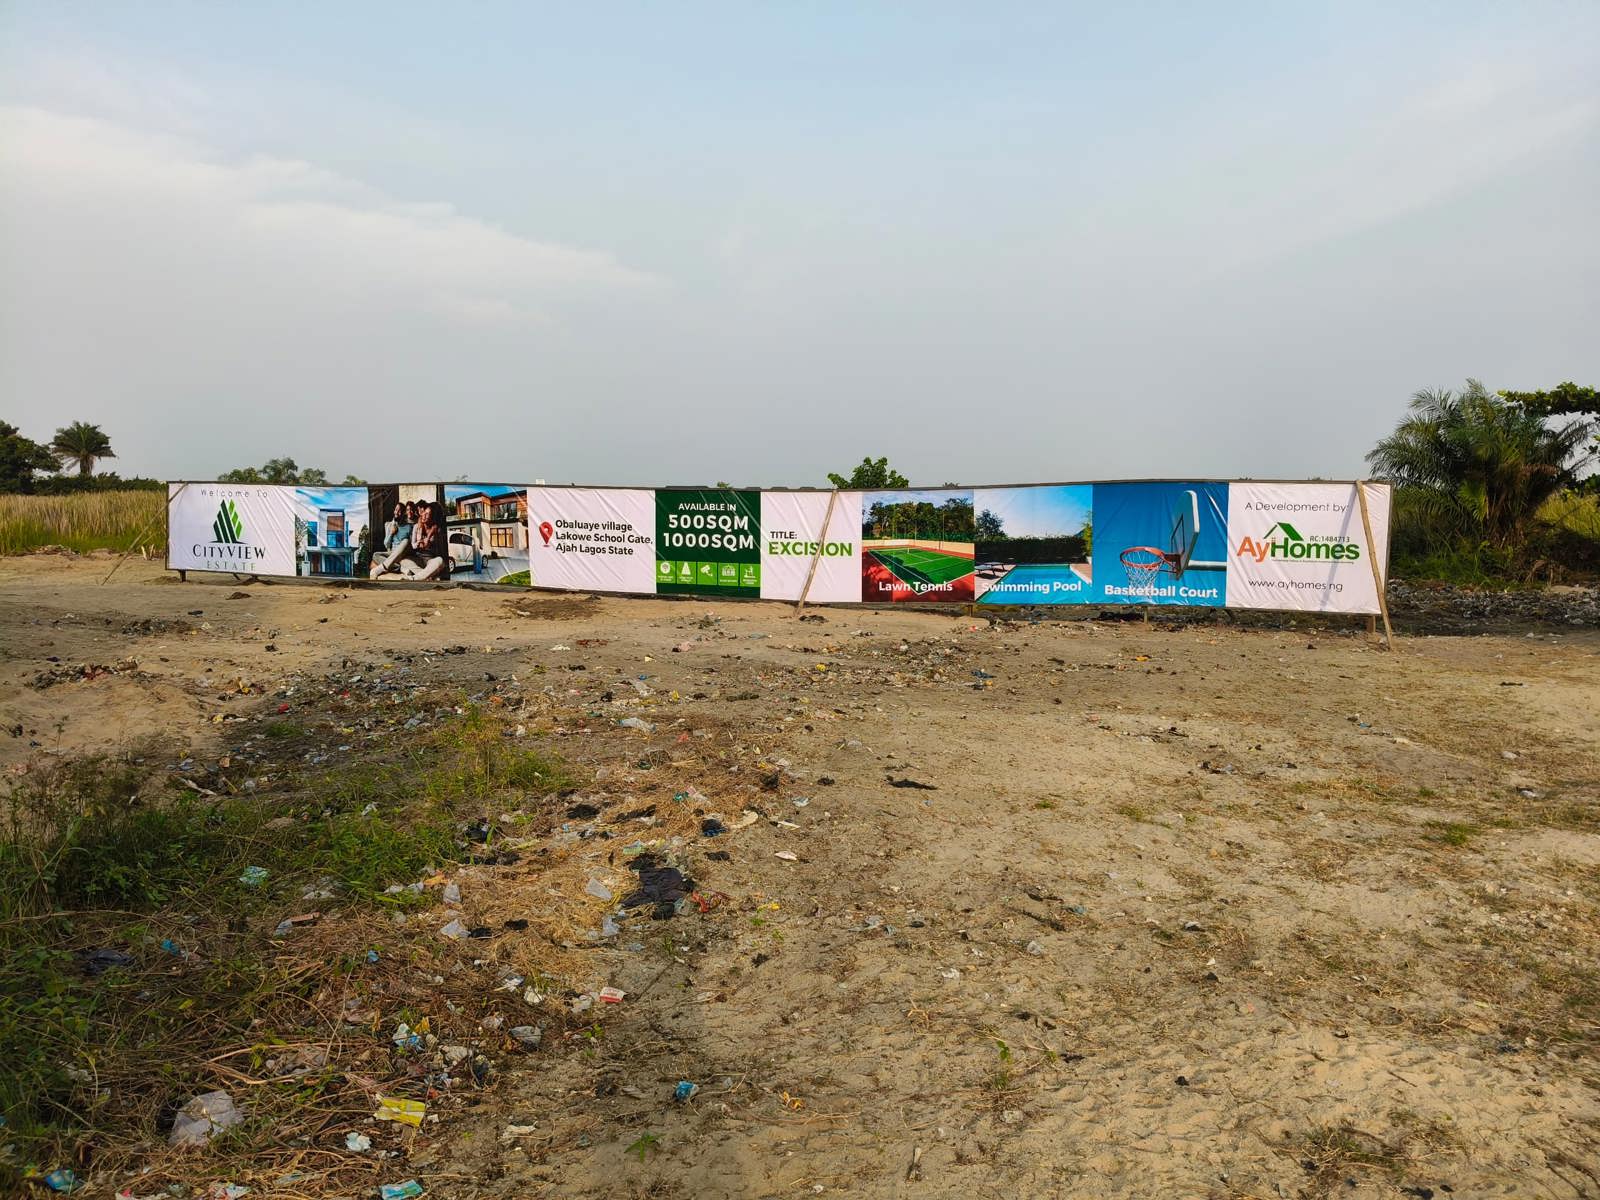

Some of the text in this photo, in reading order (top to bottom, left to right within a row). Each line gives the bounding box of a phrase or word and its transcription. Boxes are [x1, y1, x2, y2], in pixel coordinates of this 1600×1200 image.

[678, 502, 737, 512] AVAILABLE IN
[1244, 502, 1253, 510] A
[1255, 501, 1331, 512] Development
[555, 519, 633, 533] Obaluaye village
[668, 514, 749, 533] 500SQM
[555, 531, 653, 545] Lakowe School Gate,
[770, 531, 797, 539] TITLE:
[663, 532, 754, 552] 1000SQM
[556, 543, 634, 555] Ajah Lagos State
[768, 541, 853, 557] EXCISION
[206, 560, 257, 571] ESTATE
[878, 581, 953, 592] Lawn Tennis
[982, 581, 1082, 593] Swimming Pool
[1104, 585, 1218, 599] Basketball Court
